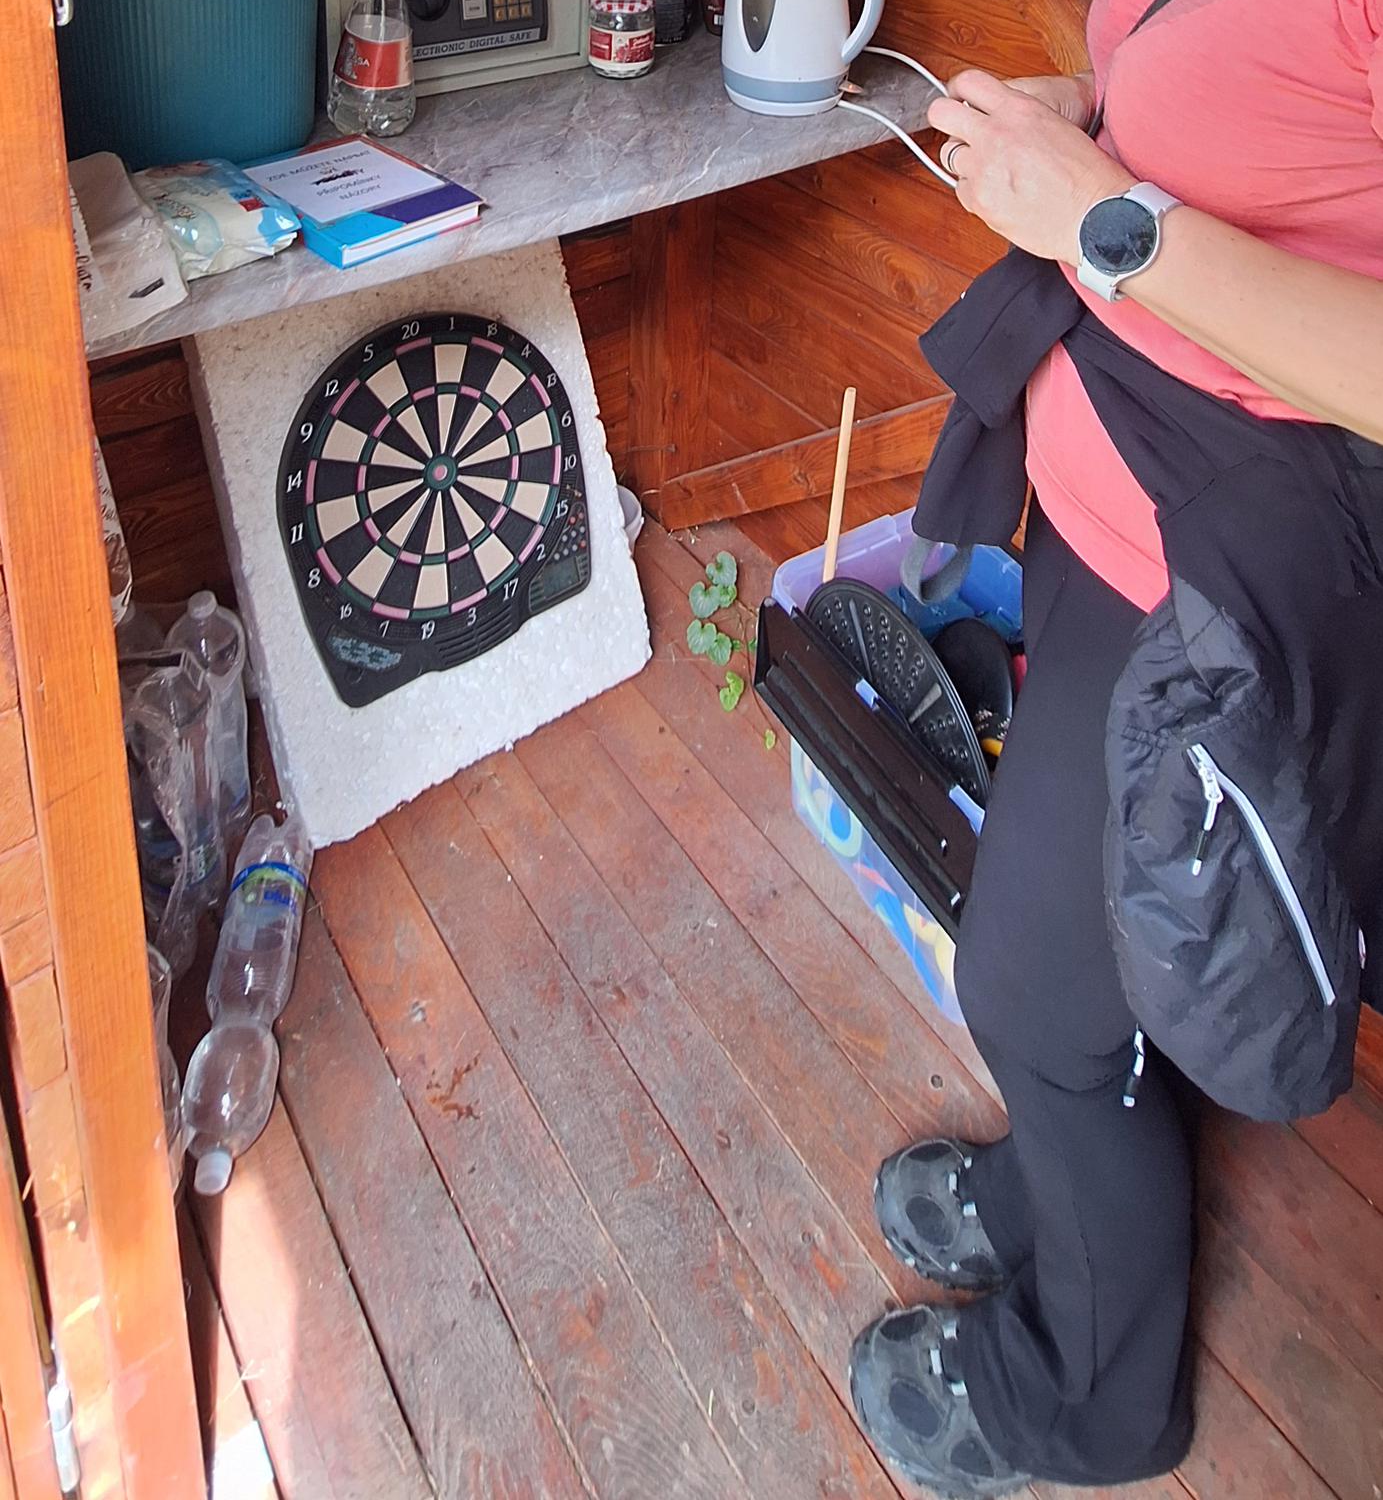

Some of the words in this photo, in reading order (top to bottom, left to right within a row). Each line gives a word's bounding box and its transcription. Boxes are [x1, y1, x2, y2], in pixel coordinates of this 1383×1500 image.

[469, 35, 505, 49] DIGITAL
[509, 30, 533, 41] SAFE
[401, 321, 420, 340] 20
[450, 317, 455, 331] 1
[487, 322, 499, 337] 18
[363, 343, 374, 363] 5
[520, 343, 532, 358] 4
[324, 379, 340, 398] 12
[546, 373, 557, 388] 13
[560, 412, 572, 428] 6
[300, 422, 314, 443] 9
[563, 455, 576, 471] 10
[286, 470, 303, 493] 14
[555, 500, 569, 519] 15
[290, 523, 304, 544] 11
[536, 544, 547, 562] 2
[307, 568, 321, 588] 8
[503, 578, 519, 600] 17
[340, 603, 352, 619] 16
[467, 607, 477, 626] 3
[380, 620, 390, 638] 7
[421, 620, 436, 640] 19
